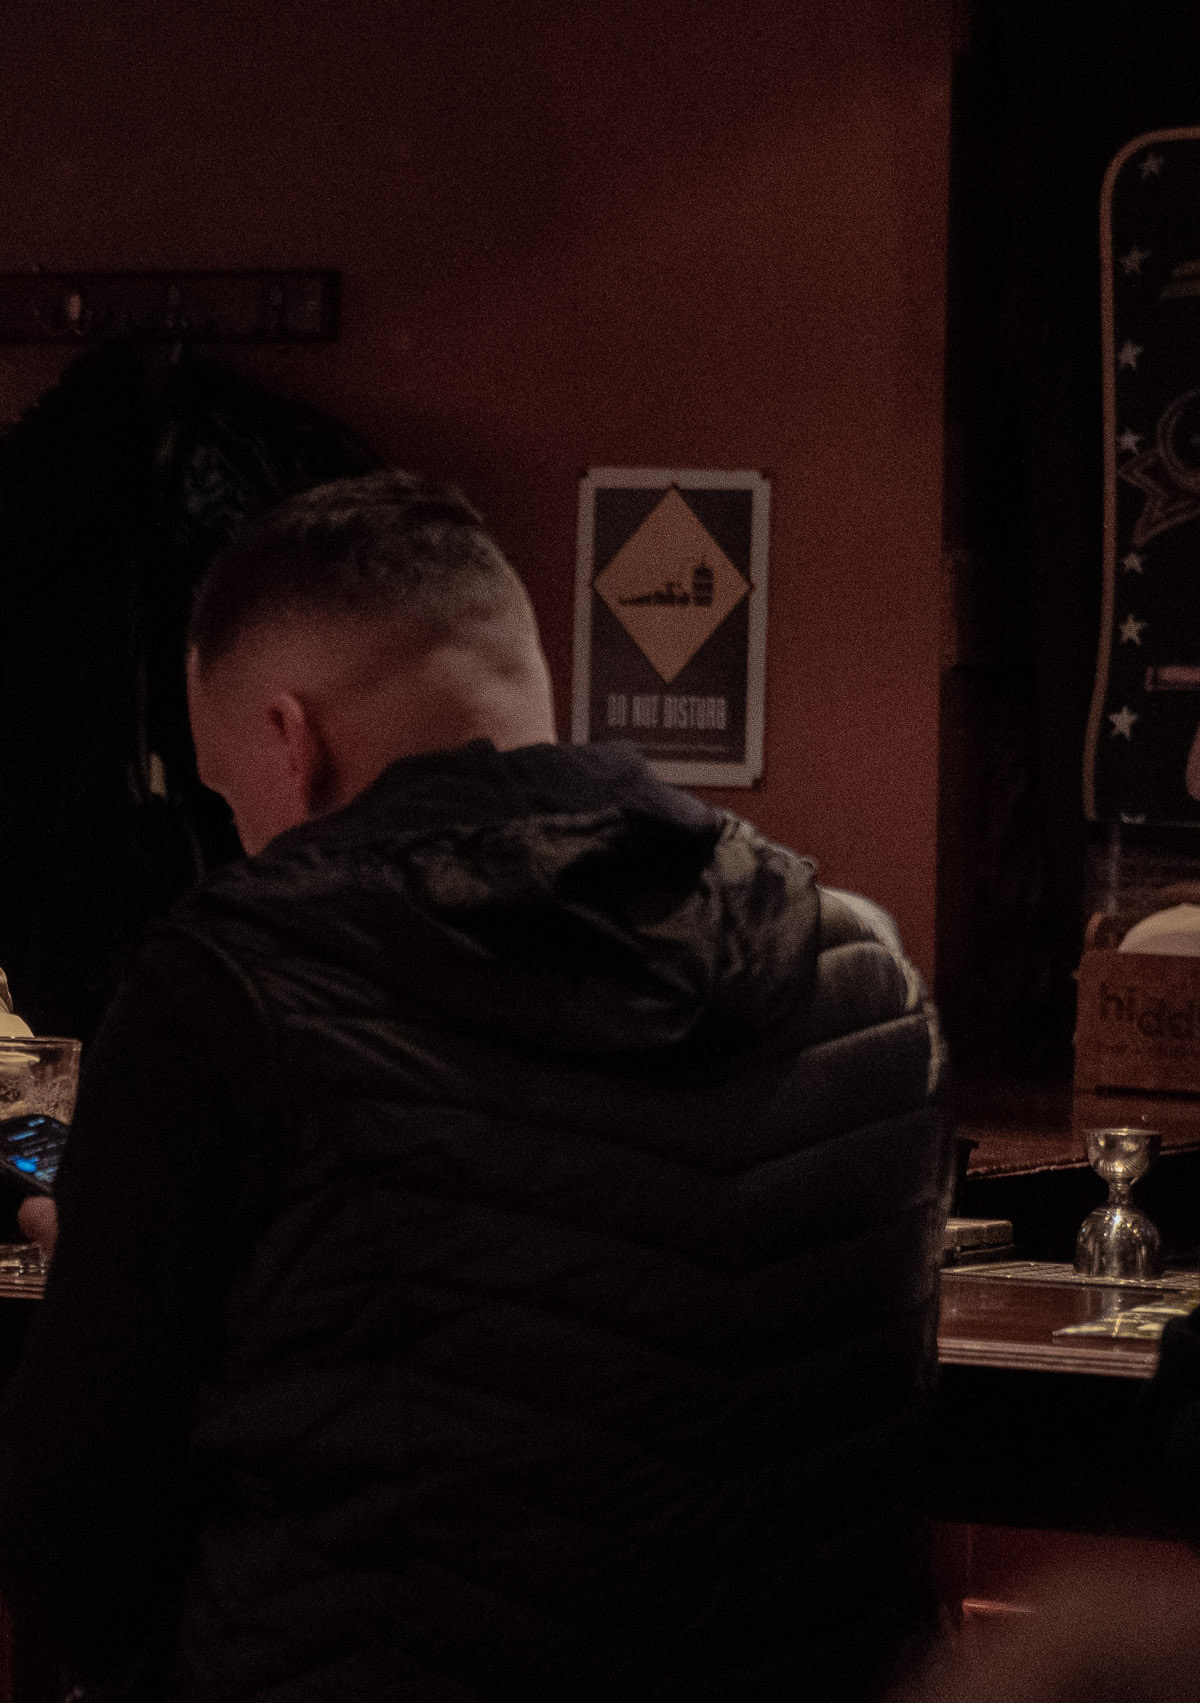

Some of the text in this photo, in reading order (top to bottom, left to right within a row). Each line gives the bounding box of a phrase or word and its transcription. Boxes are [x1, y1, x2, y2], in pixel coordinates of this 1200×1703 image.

[607, 693, 728, 730] DO NOT DISTURB
